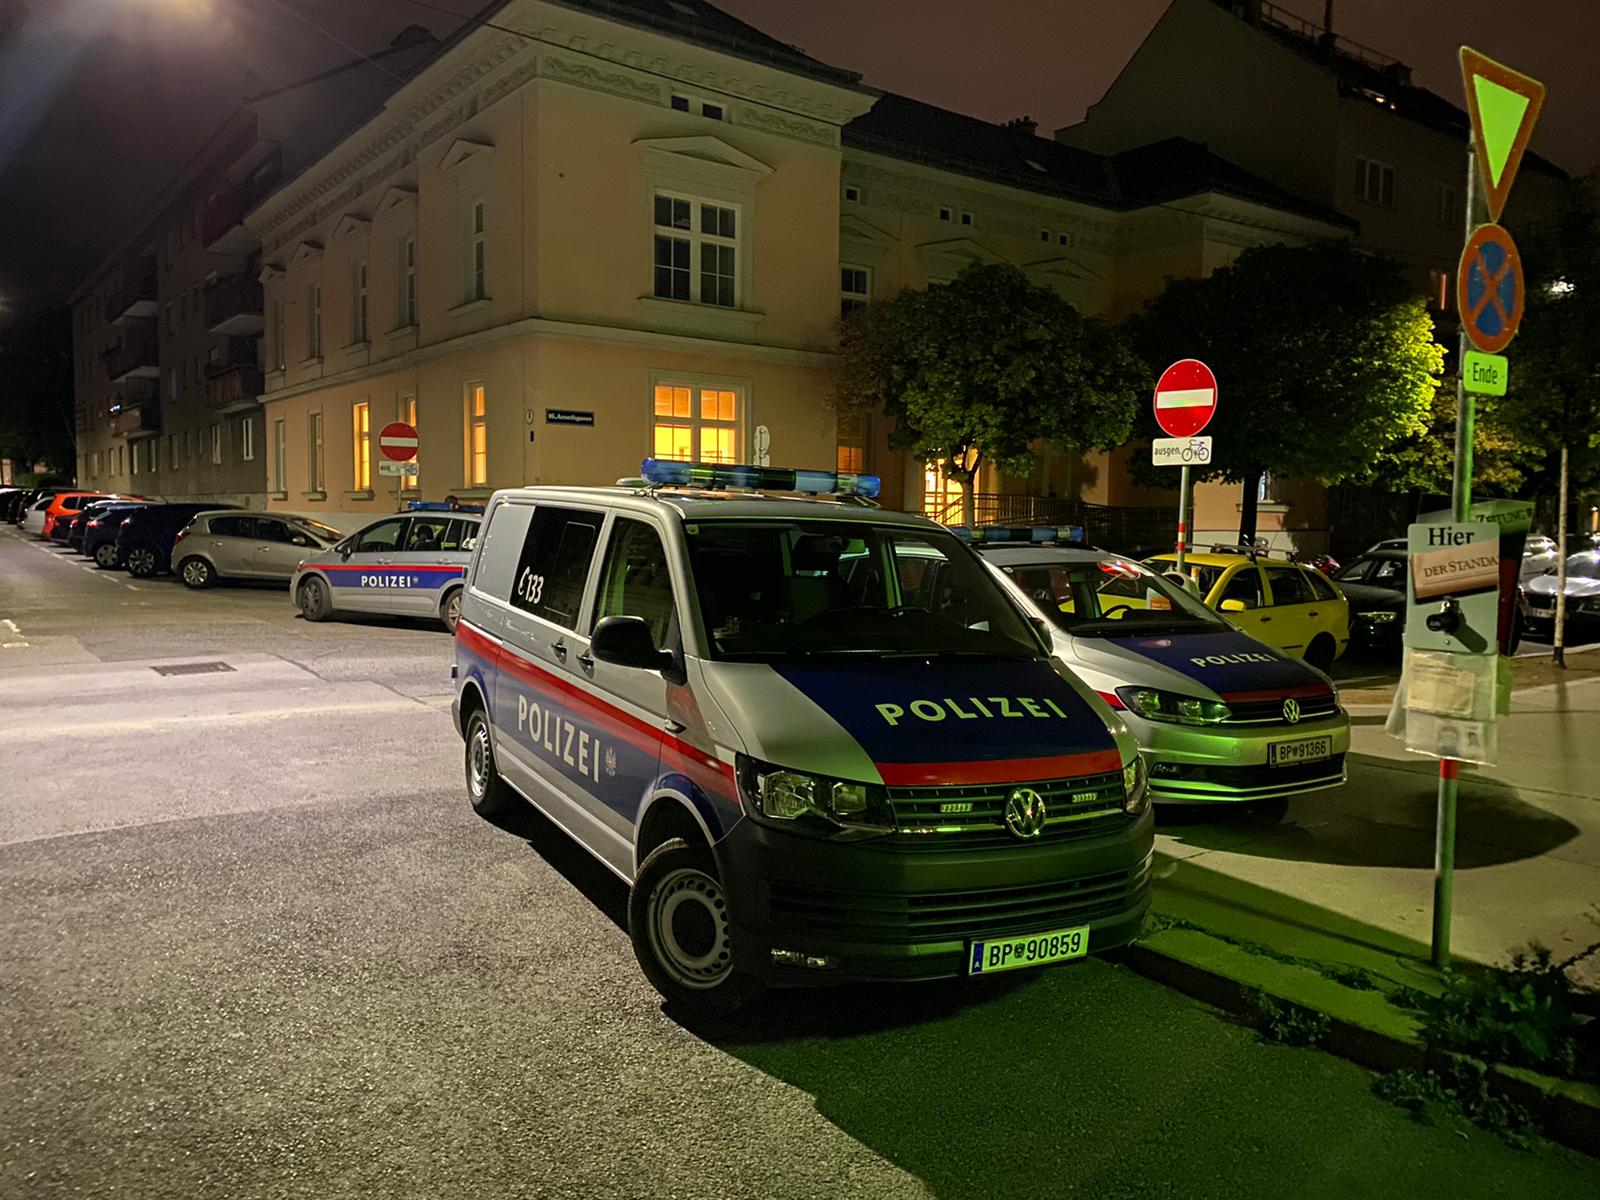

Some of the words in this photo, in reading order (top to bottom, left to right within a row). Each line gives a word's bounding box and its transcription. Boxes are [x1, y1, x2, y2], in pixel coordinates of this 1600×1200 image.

[1472, 361, 1498, 385] Ende
[1154, 446, 1181, 458] ausgen.
[1428, 526, 1475, 546] Hier
[361, 575, 411, 588] POLIZEI
[1423, 565, 1448, 578] DER
[525, 574, 545, 604] 133
[1190, 653, 1280, 668] POLIZEI
[875, 697, 1068, 727] POLIZEI
[518, 694, 600, 784] POLIZEI
[1280, 745, 1292, 760] BP
[1299, 741, 1326, 757] 91366
[989, 943, 1013, 967] BP
[1026, 932, 1081, 961] 90859
